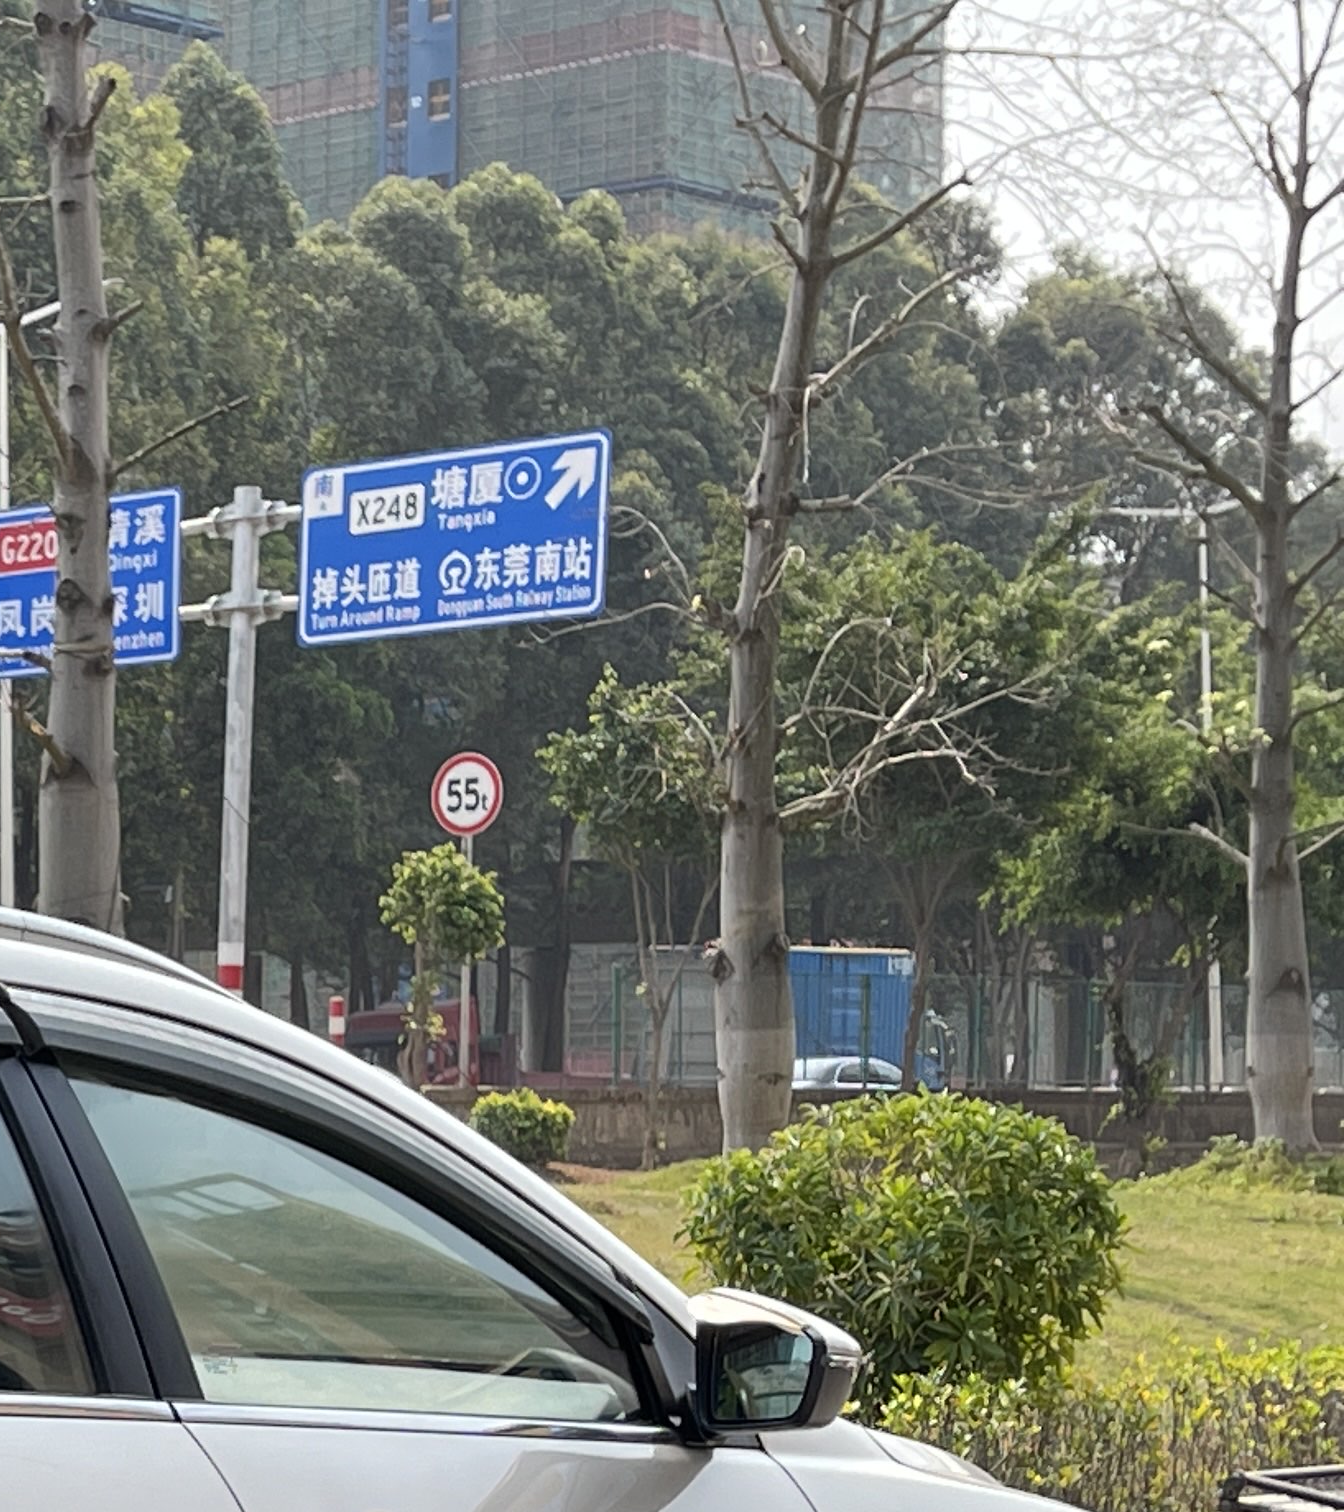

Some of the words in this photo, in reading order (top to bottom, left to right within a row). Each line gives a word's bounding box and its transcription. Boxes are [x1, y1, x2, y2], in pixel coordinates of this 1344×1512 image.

[430, 461, 504, 509] 塘厦
[356, 491, 418, 527] X248
[436, 508, 497, 533] Tangxia
[1, 529, 59, 565] G220
[473, 536, 593, 592] 东莞南站
[312, 557, 422, 611] 掉头匝道
[437, 598, 485, 618] Dongguan
[486, 592, 515, 612] South
[515, 588, 554, 609] Railway
[556, 583, 592, 604] Station
[311, 612, 338, 631] Turn
[339, 606, 385, 627] Around
[385, 604, 421, 623] Ramp
[113, 629, 165, 651] enzhen
